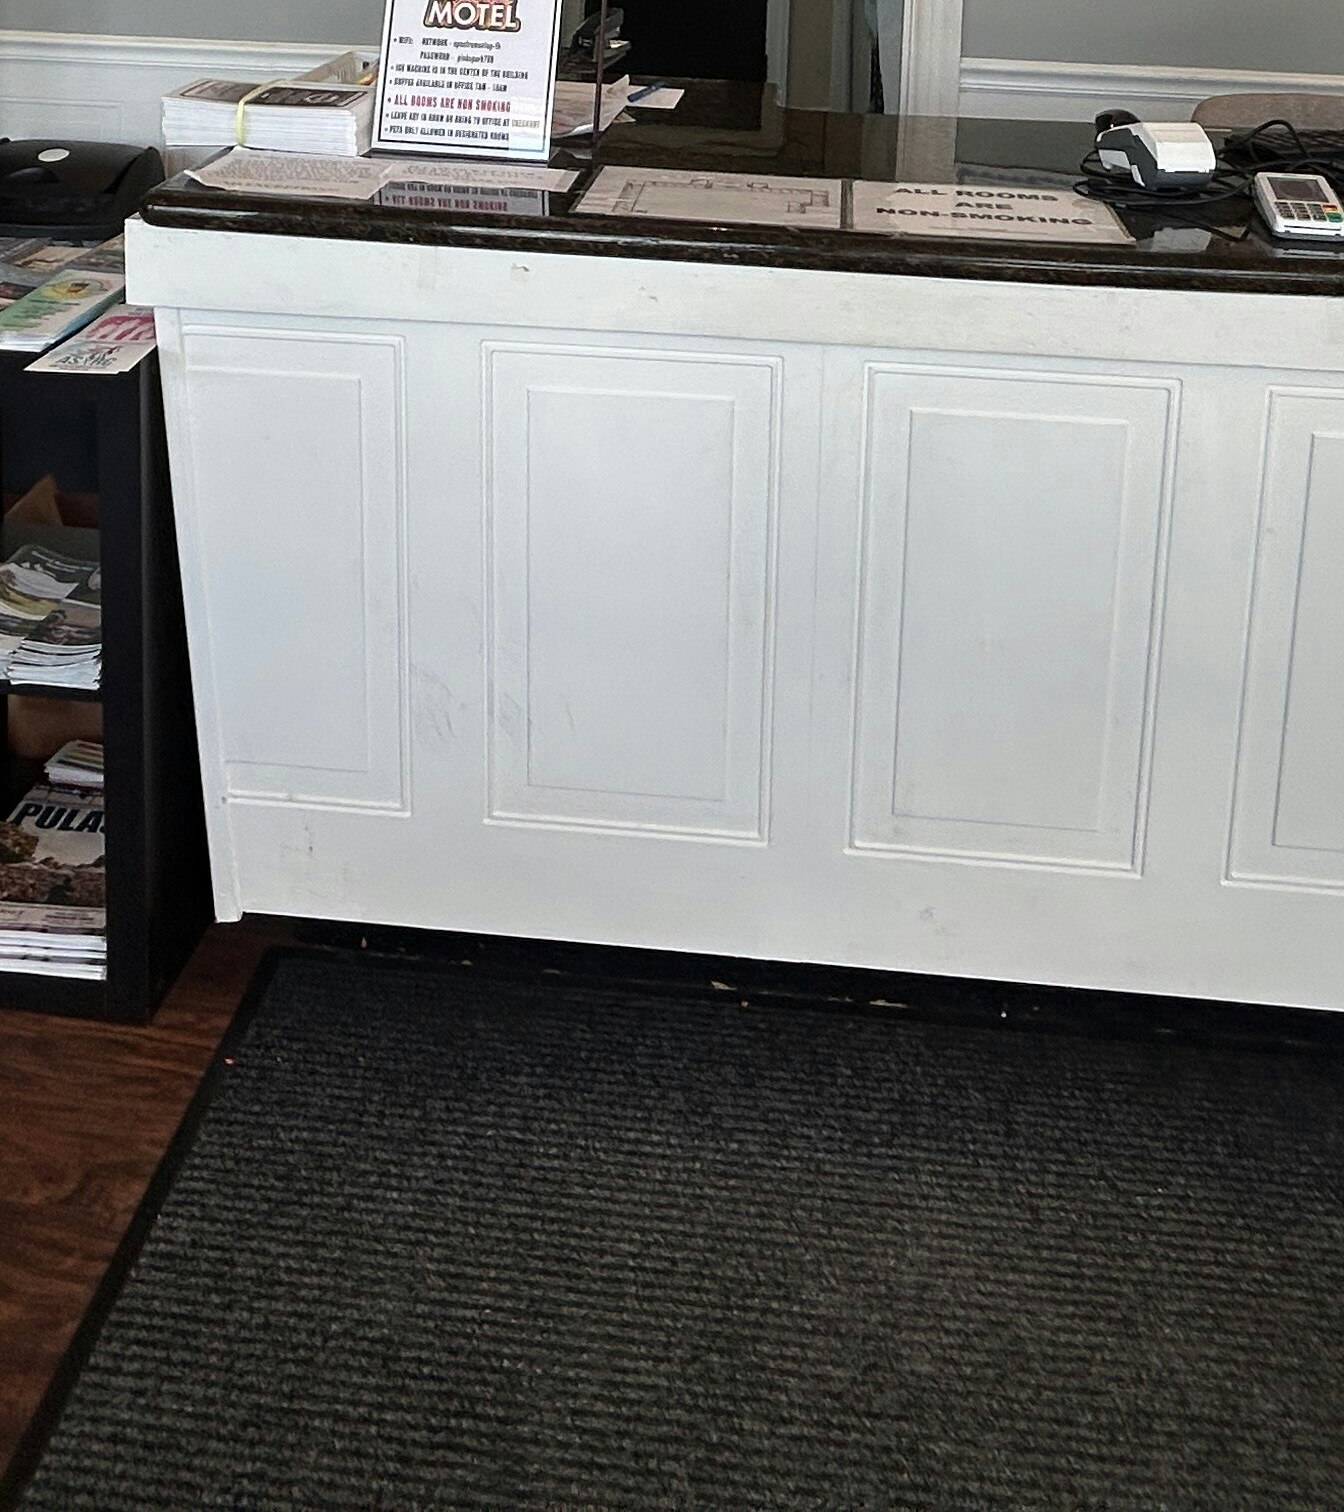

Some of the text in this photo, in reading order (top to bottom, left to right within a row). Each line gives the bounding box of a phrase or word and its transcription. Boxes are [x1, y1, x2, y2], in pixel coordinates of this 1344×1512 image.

[427, 0, 517, 28] MOTEL
[448, 67, 457, 75] THE
[490, 69, 501, 78] THE
[503, 70, 528, 80] BUILDING
[416, 79, 444, 88] AVAILABLE
[394, 94, 511, 112] ALL ROOMS ARE NON SMOKING
[895, 188, 1059, 202] ALL ROOMS
[955, 201, 1014, 210] ARE
[875, 207, 1094, 225] NON-SMOKING
[14, 802, 105, 834] PULA
